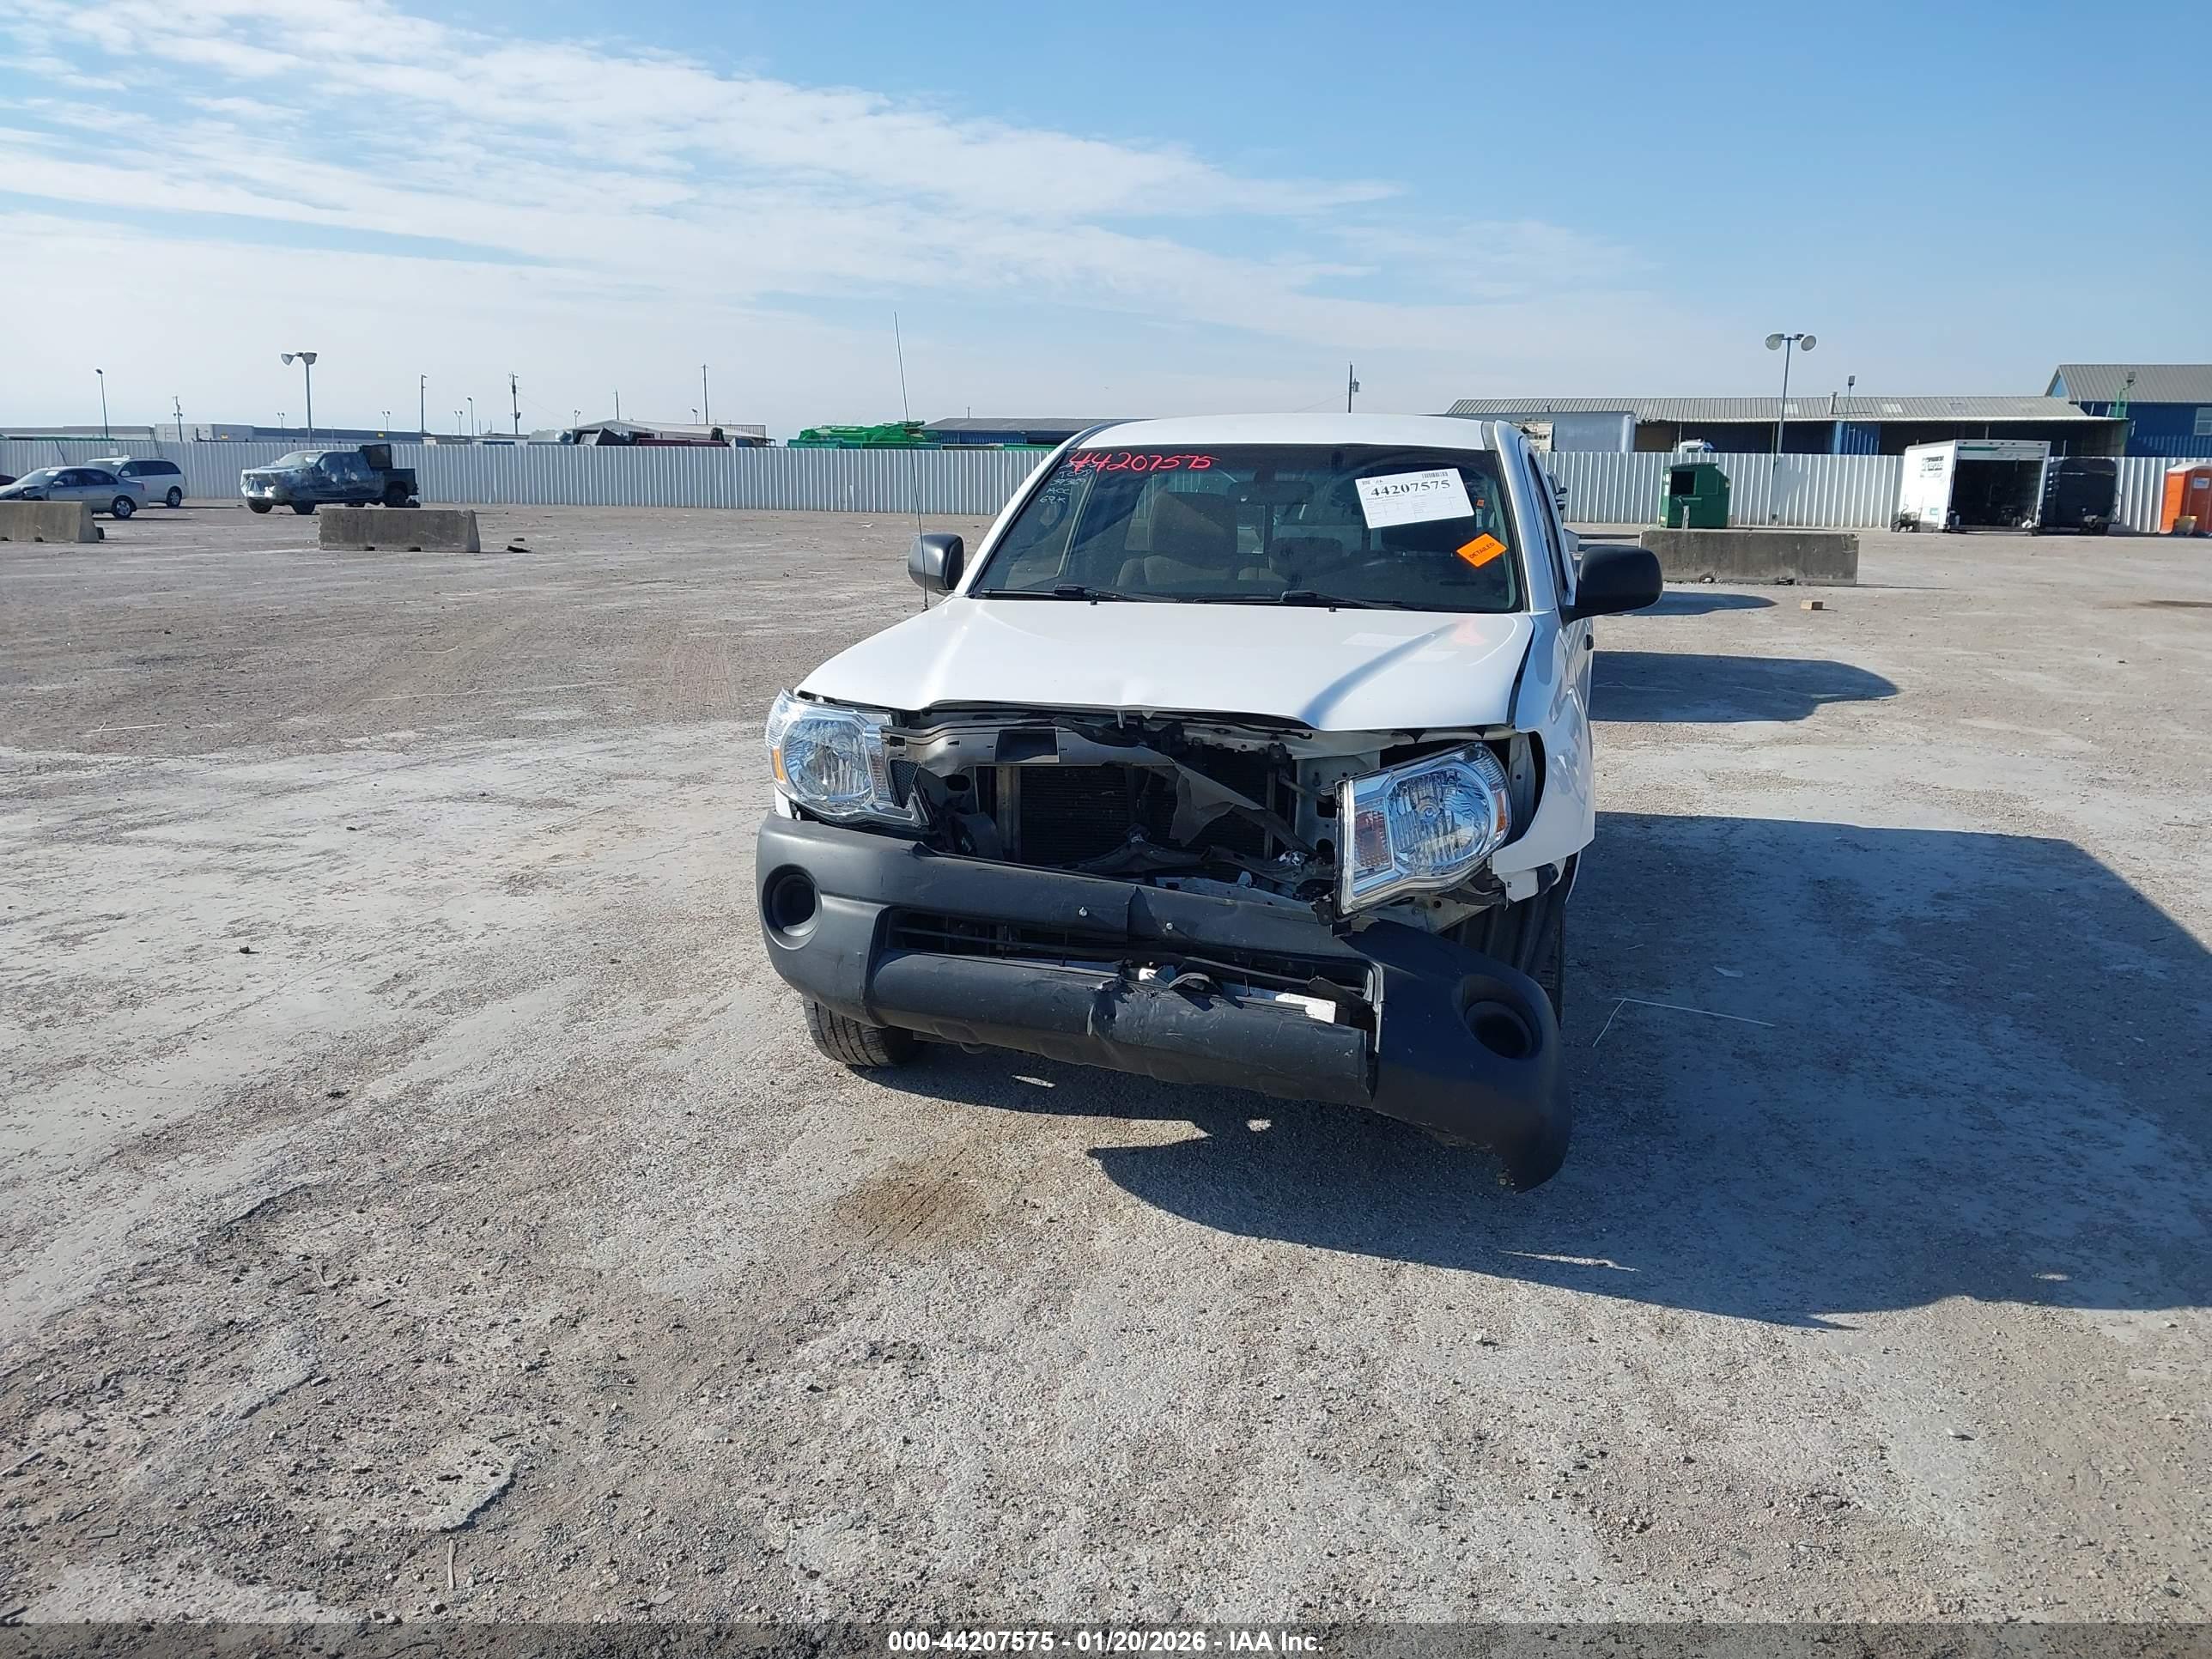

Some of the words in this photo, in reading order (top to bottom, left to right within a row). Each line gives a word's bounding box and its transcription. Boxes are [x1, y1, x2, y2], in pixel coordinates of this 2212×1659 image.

[1068, 452, 1220, 471] 44207575
[1370, 479, 1450, 496] 44207575
[1469, 542, 1496, 559] DETAILED
